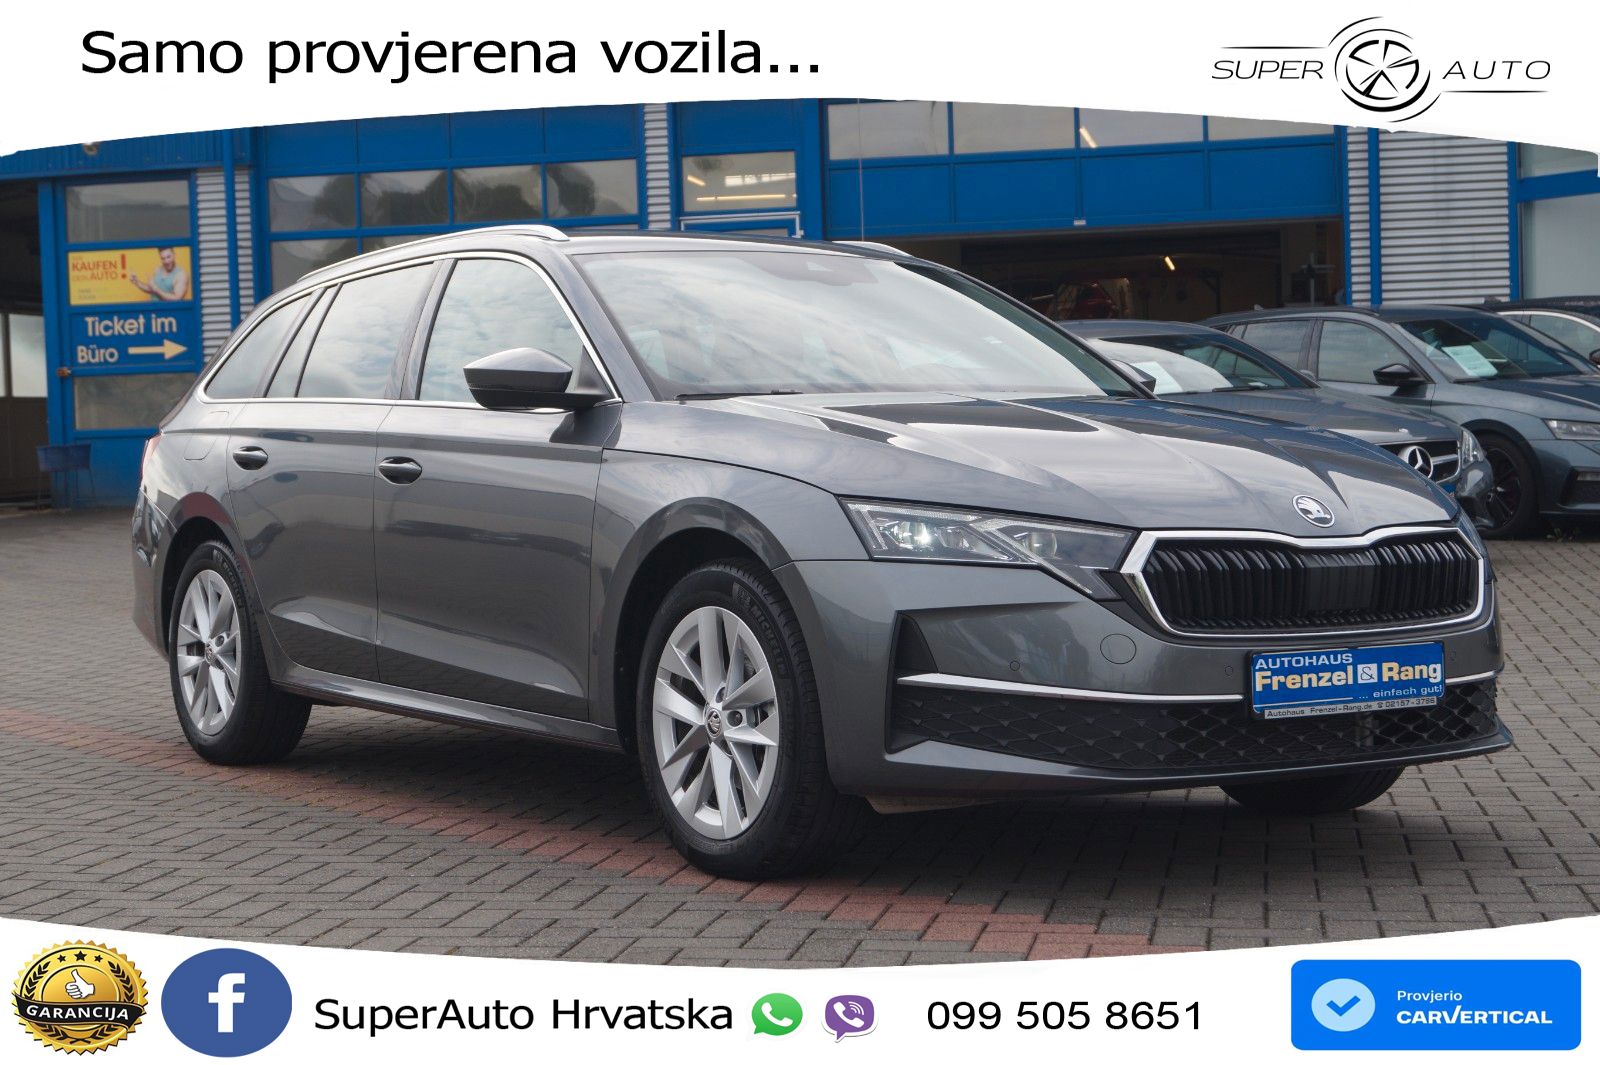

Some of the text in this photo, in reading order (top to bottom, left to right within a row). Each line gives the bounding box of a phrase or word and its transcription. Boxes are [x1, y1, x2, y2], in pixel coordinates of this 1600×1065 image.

[72, 260, 118, 271] KAUFEN
[85, 313, 177, 337] Ticket im
[77, 344, 118, 363] Büro
[1255, 653, 1353, 669] AUTOHAUS
[1255, 662, 1442, 692] Frenzel & Rang
[1373, 686, 1417, 698] einfach
[1421, 684, 1442, 696] gut!
[1266, 709, 1305, 718] Autohaus
